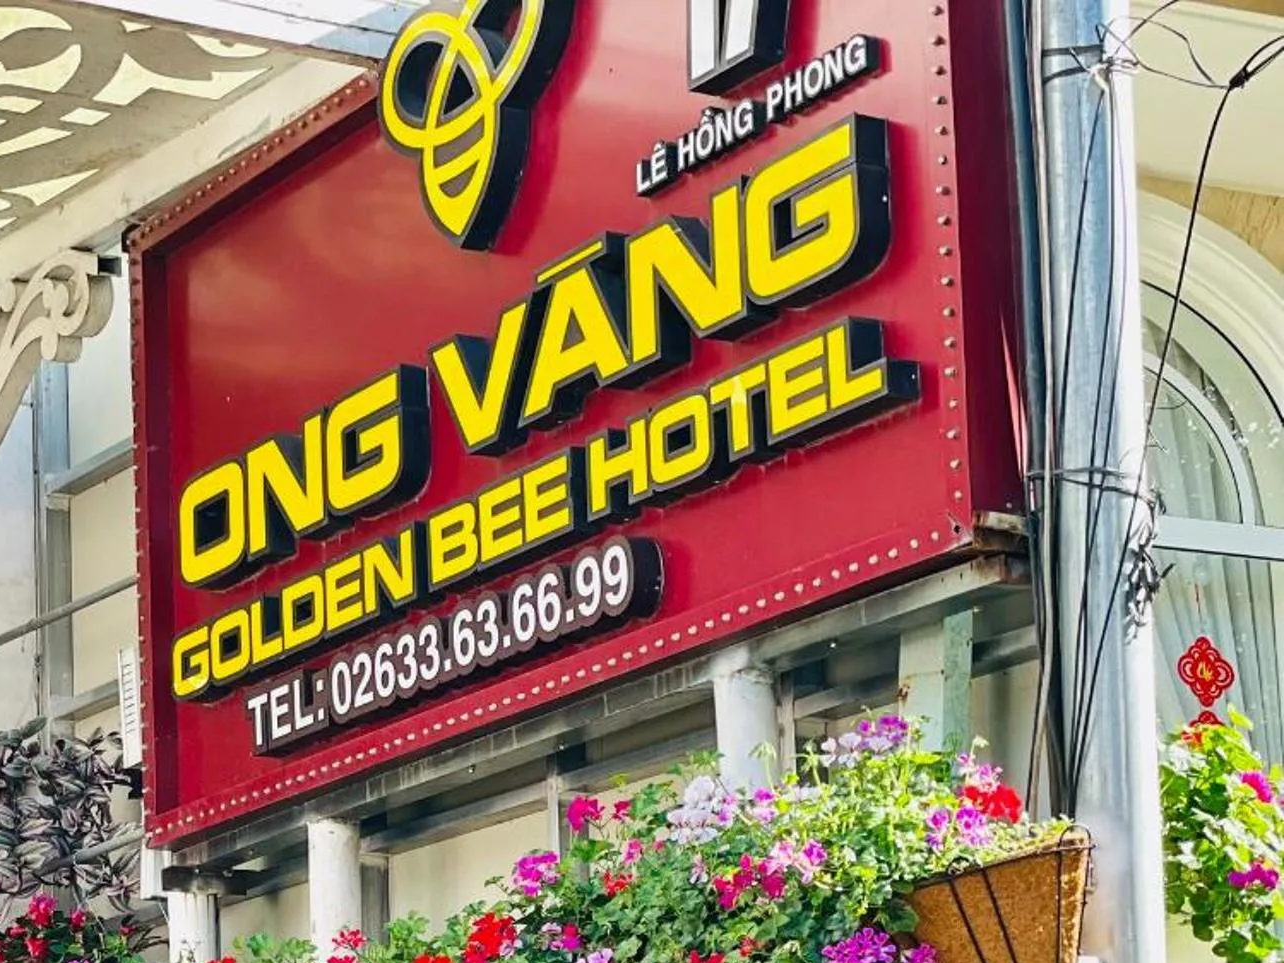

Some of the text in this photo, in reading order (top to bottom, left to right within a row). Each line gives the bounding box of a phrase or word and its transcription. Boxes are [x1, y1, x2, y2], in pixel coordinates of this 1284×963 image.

[636, 142, 668, 193] LÊ
[677, 99, 754, 171] HỒNG
[766, 36, 867, 122] PHONG
[172, 325, 884, 697] GOLDEN BEE HOTEL
[179, 371, 402, 585] ONG
[247, 544, 629, 747] TEL: 02633.63.66.99
